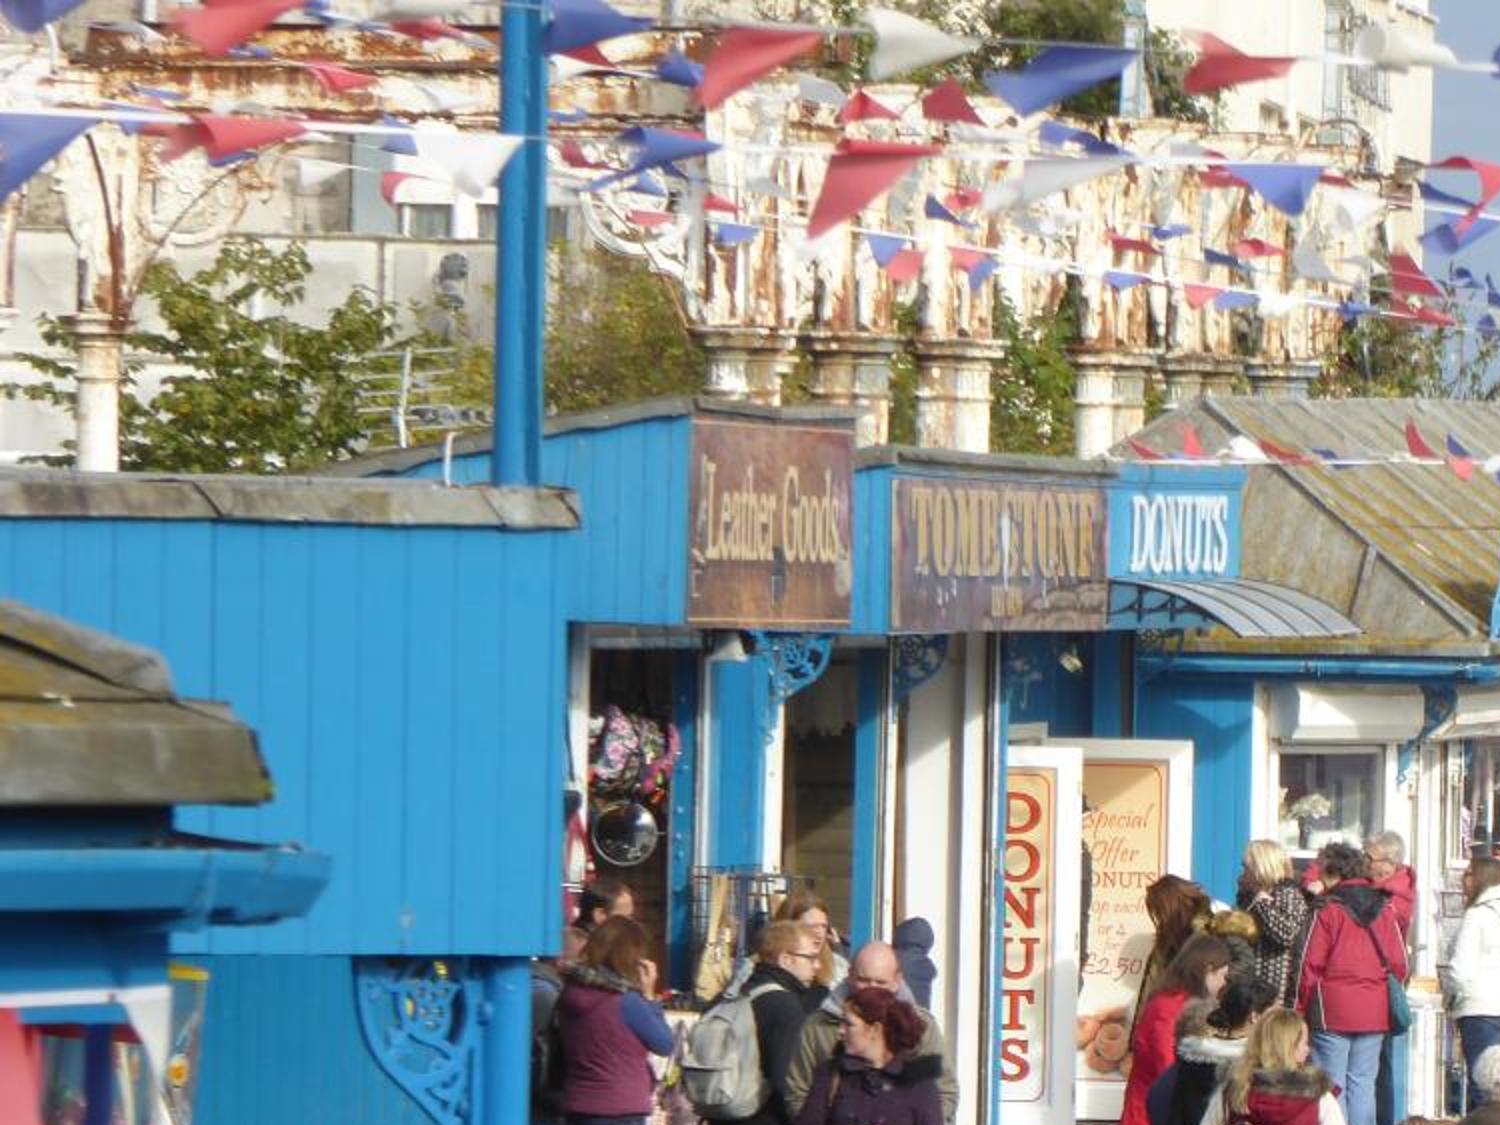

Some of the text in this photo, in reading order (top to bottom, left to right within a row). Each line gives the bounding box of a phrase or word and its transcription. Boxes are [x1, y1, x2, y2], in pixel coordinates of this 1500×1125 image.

[705, 463, 840, 563] Leather Goods
[911, 486, 1097, 577] TOMBSTONE
[1130, 494, 1228, 575] DONUTS
[1083, 804, 1154, 838] Special
[1091, 871, 1156, 888] ONUTS
[1092, 838, 1140, 870] Offer
